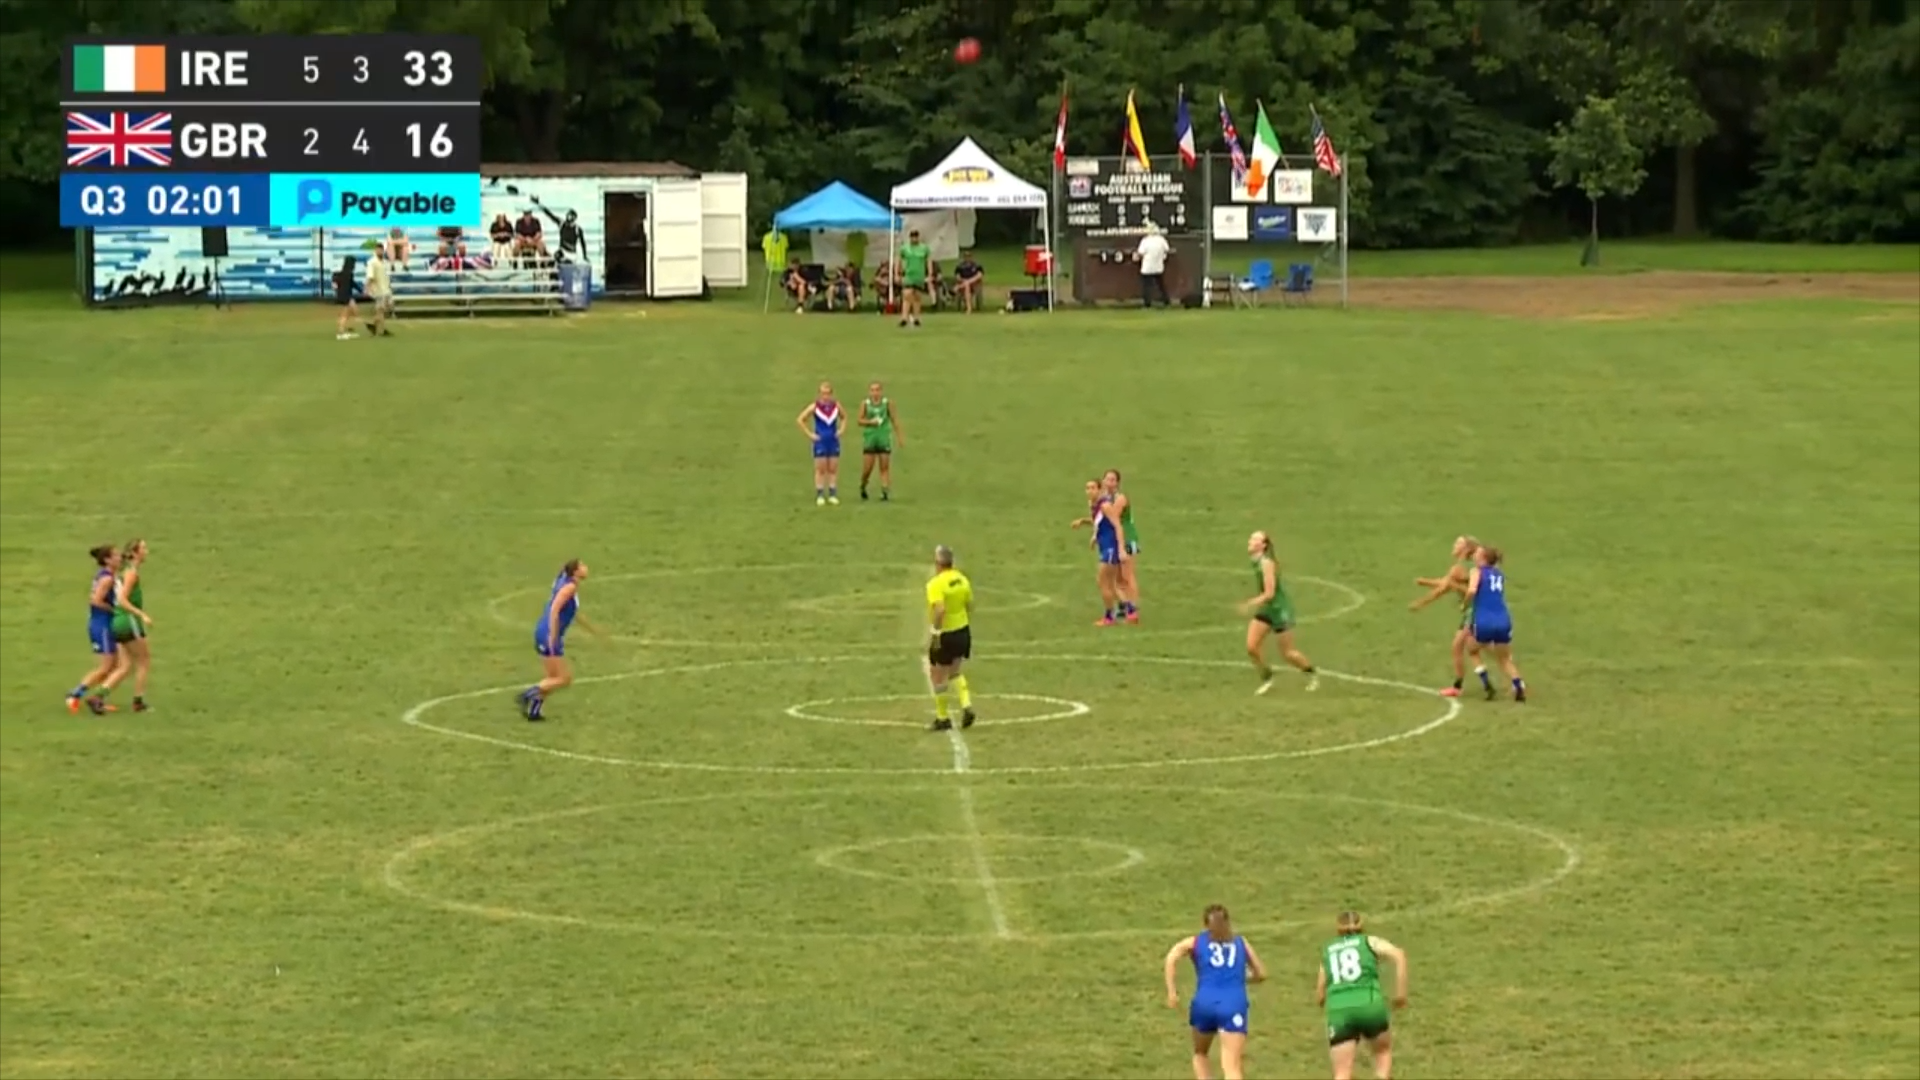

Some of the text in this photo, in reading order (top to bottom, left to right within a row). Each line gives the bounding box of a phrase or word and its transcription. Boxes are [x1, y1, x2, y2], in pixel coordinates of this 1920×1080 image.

[1109, 173, 1172, 184] AUSTRALIAN
[1094, 184, 1142, 195] FOOTBALL
[1146, 183, 1183, 194] LEAGUE
[1209, 943, 1236, 968] 37
[1329, 947, 1361, 984] 18
